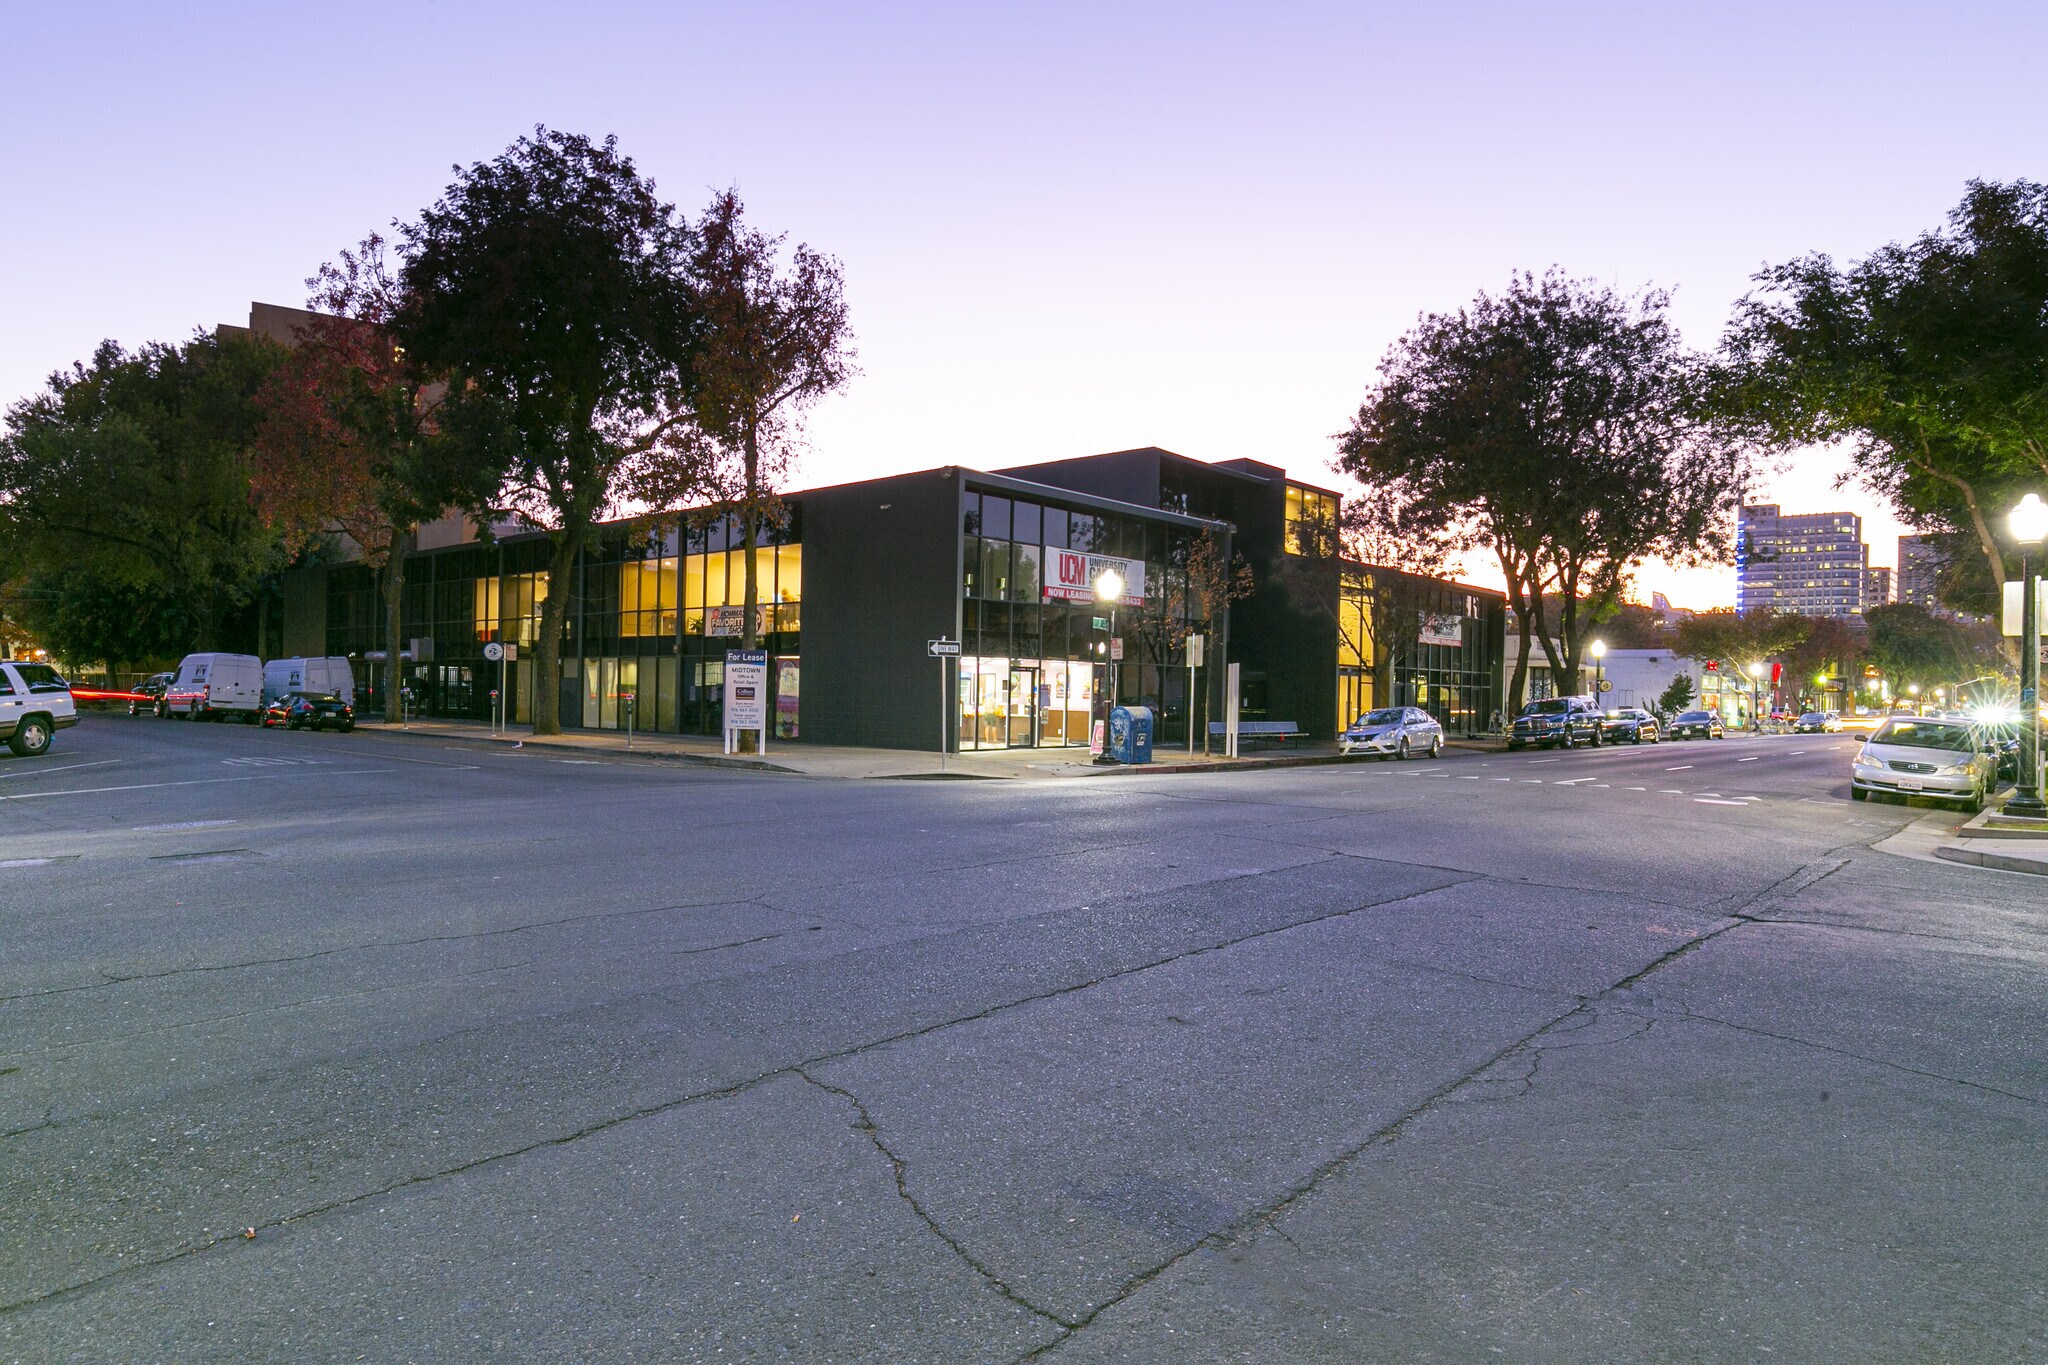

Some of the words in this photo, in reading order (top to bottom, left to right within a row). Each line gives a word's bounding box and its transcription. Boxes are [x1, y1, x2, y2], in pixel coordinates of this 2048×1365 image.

[1059, 553, 1086, 586] UCM
[1089, 557, 1128, 571] UNIVERSITY
[1089, 566, 1126, 581] CAAL
[1048, 587, 1065, 597] NOW
[1066, 589, 1095, 601] LEASING
[728, 626, 745, 635] SHO
[728, 653, 740, 661] For
[743, 653, 764, 661] Lease
